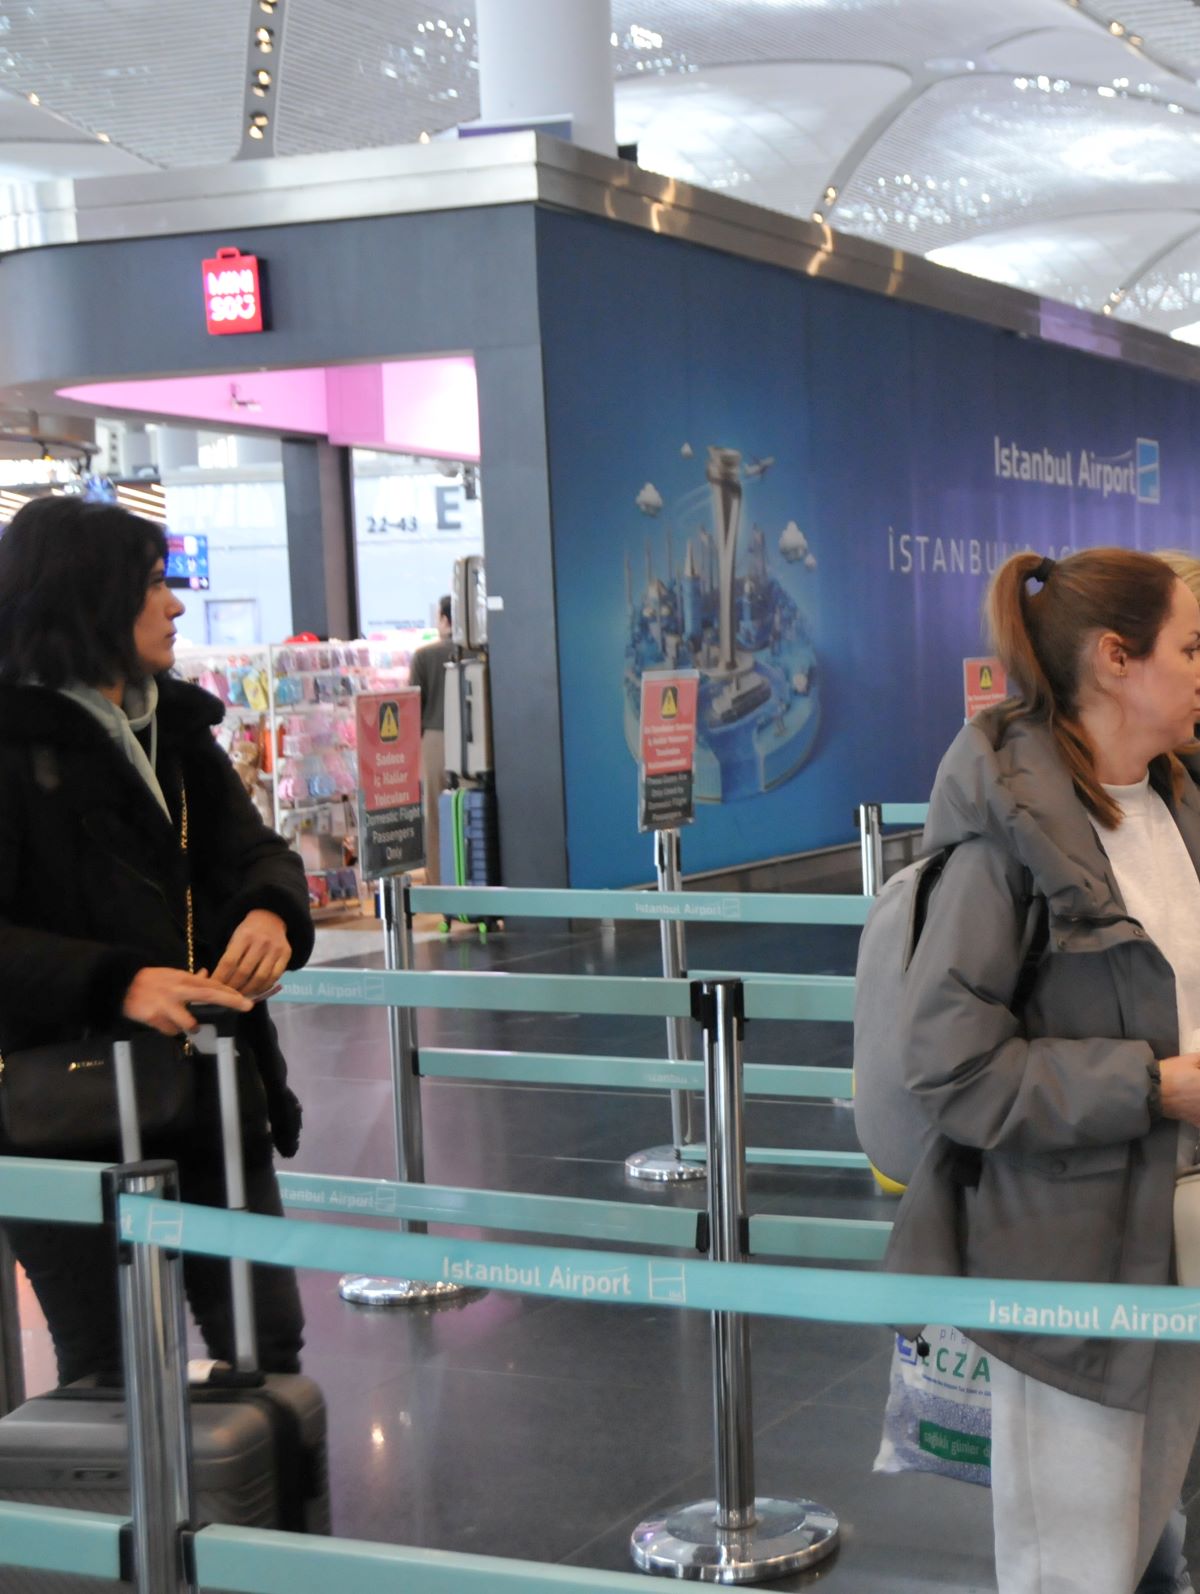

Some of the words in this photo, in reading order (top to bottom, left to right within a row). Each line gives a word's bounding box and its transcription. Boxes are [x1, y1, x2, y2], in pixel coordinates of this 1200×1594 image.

[207, 269, 254, 296] MINI
[994, 436, 1073, 486] Istanbul
[1078, 450, 1136, 498] Airport
[436, 486, 461, 530] E
[888, 527, 1034, 576] İSTANBU
[635, 902, 681, 915] Istanbul
[683, 903, 721, 916] Airport
[443, 1256, 541, 1287] Istanbul
[549, 1265, 632, 1296] Airport
[988, 1298, 1100, 1330] Istanbul
